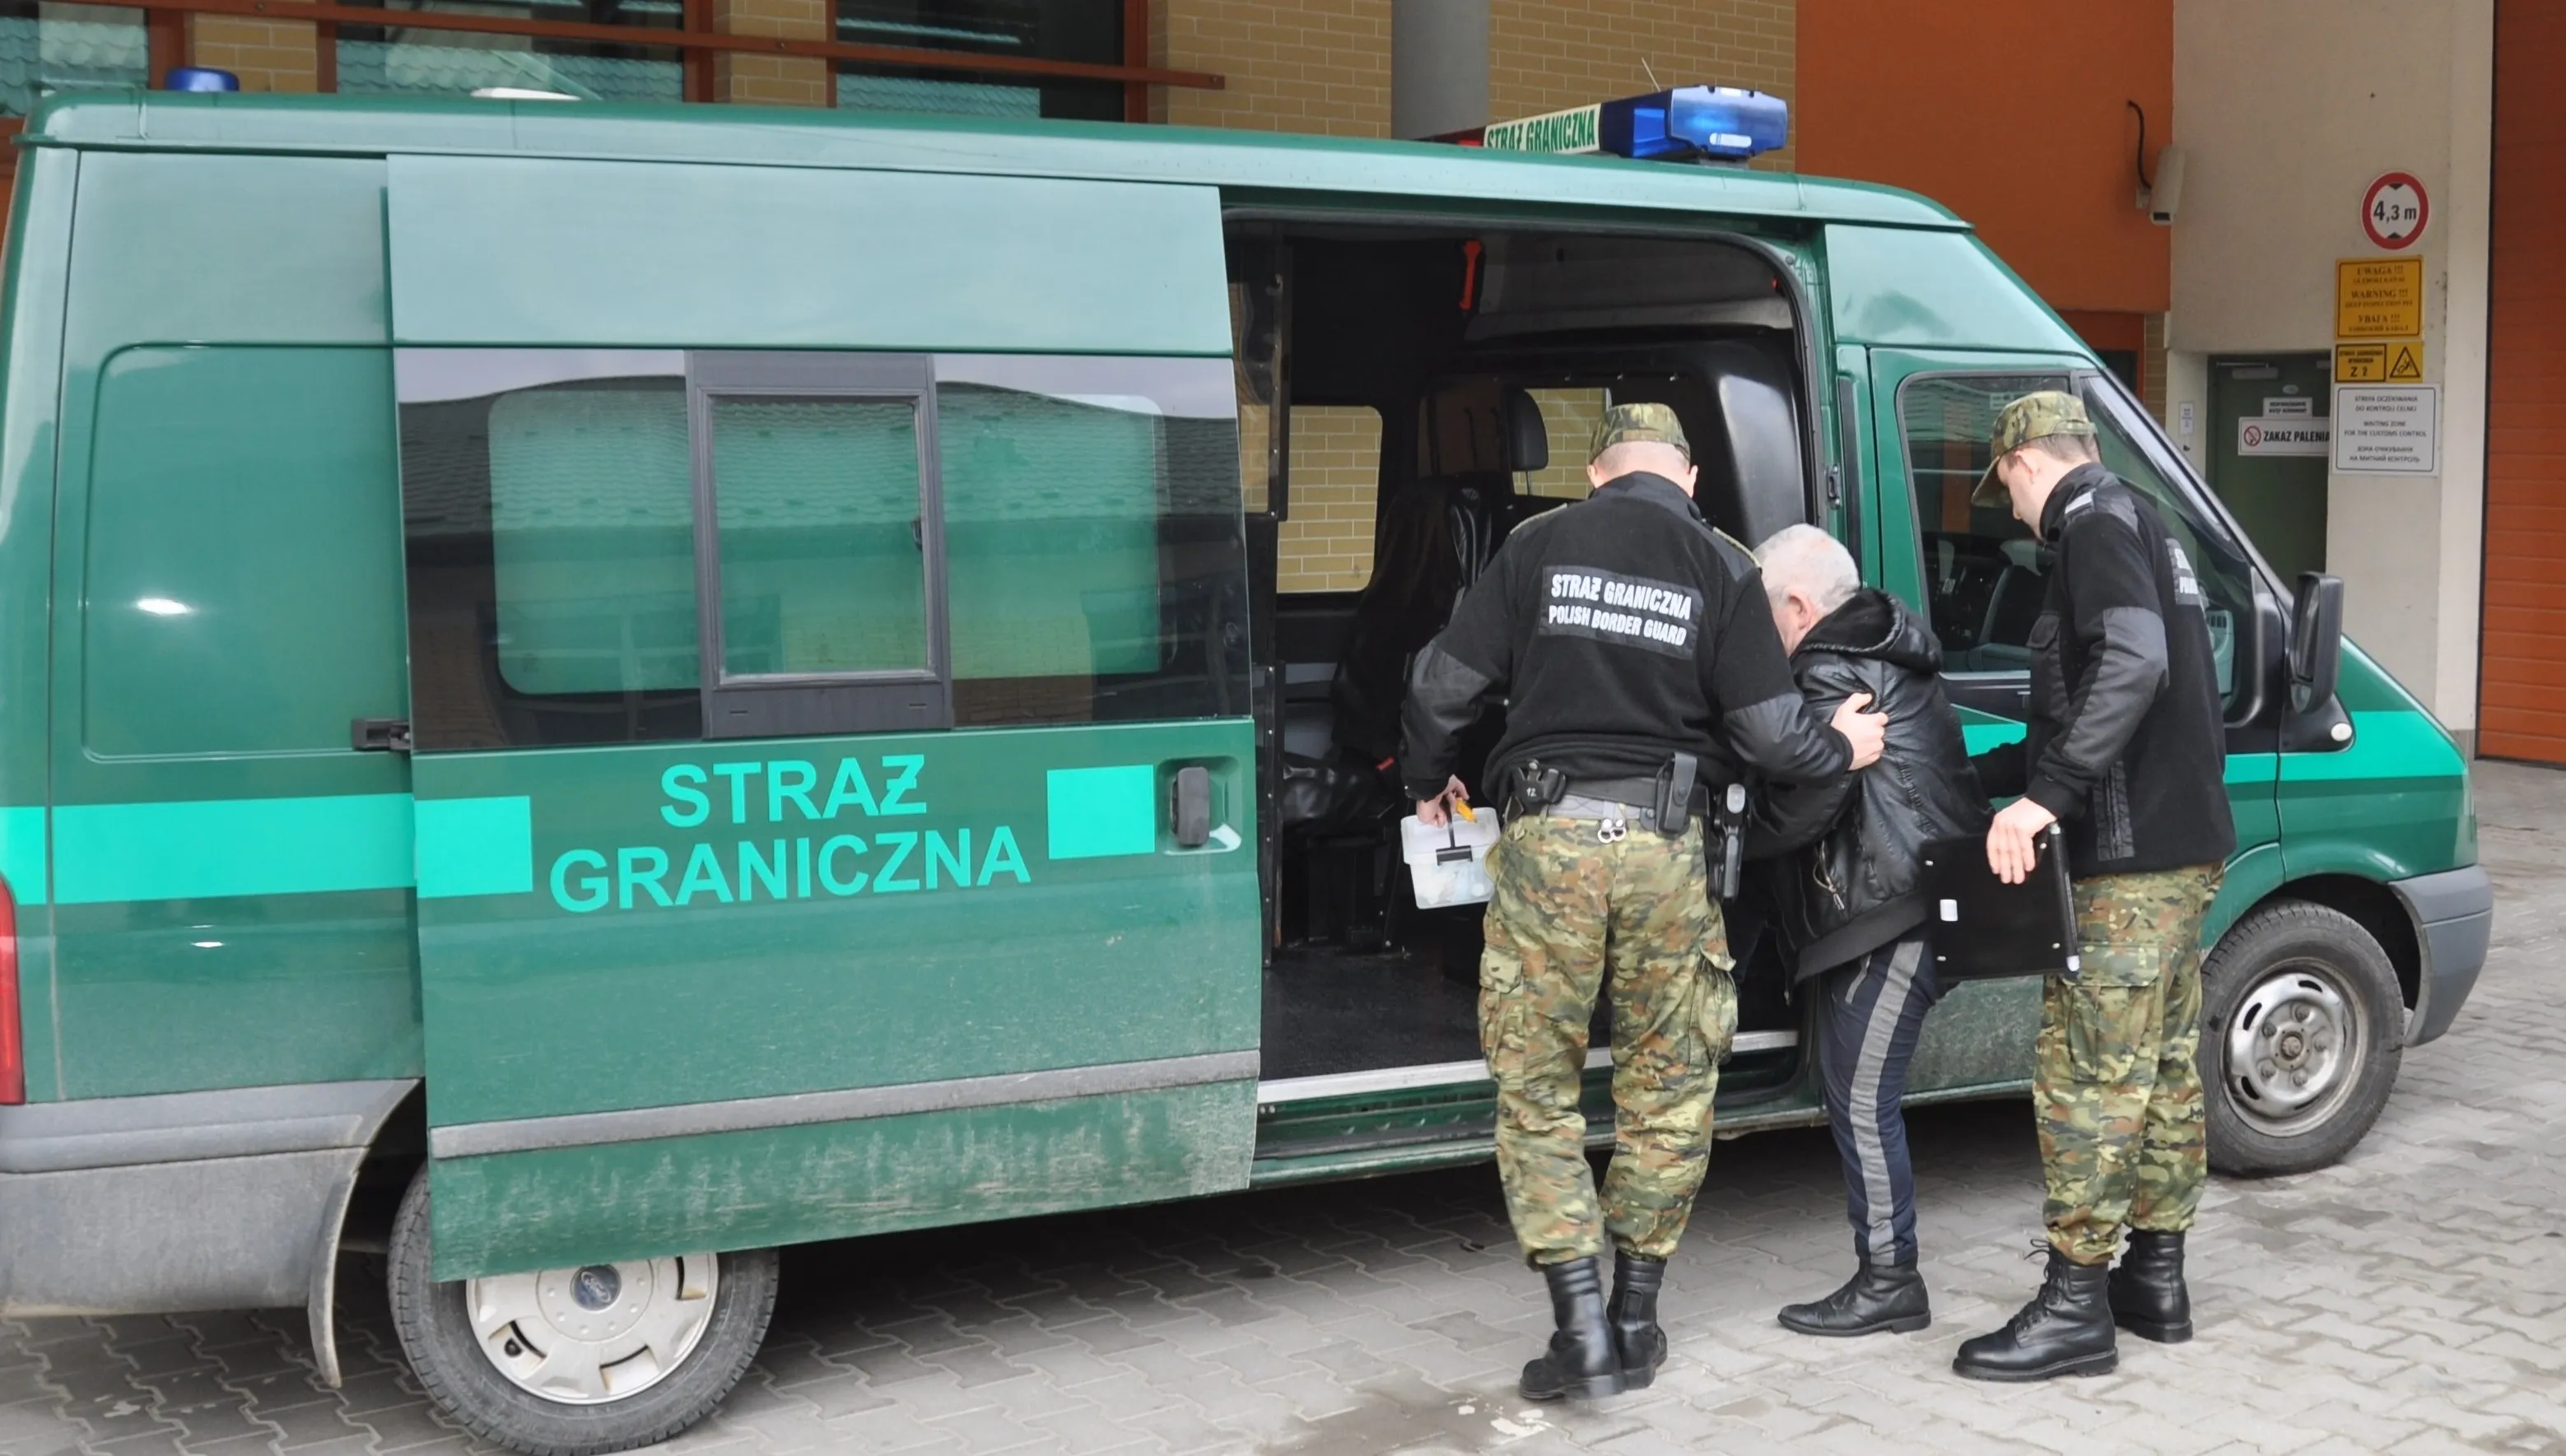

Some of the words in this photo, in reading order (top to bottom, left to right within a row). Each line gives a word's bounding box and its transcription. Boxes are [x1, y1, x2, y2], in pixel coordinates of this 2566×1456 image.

[1525, 109, 1595, 152] GRANICZNA
[2373, 200, 2400, 224] 4,3
[2404, 207, 2417, 220] m
[2351, 290, 2396, 298] WARNING
[2263, 430, 2292, 442] ZAKAZ
[1604, 581, 1692, 620] GRANICZNA
[1548, 605, 1591, 626] POLISH
[1591, 609, 1643, 635] BORDER
[1643, 619, 1687, 646] GUARD
[549, 826, 1032, 914] GRANICZNA
